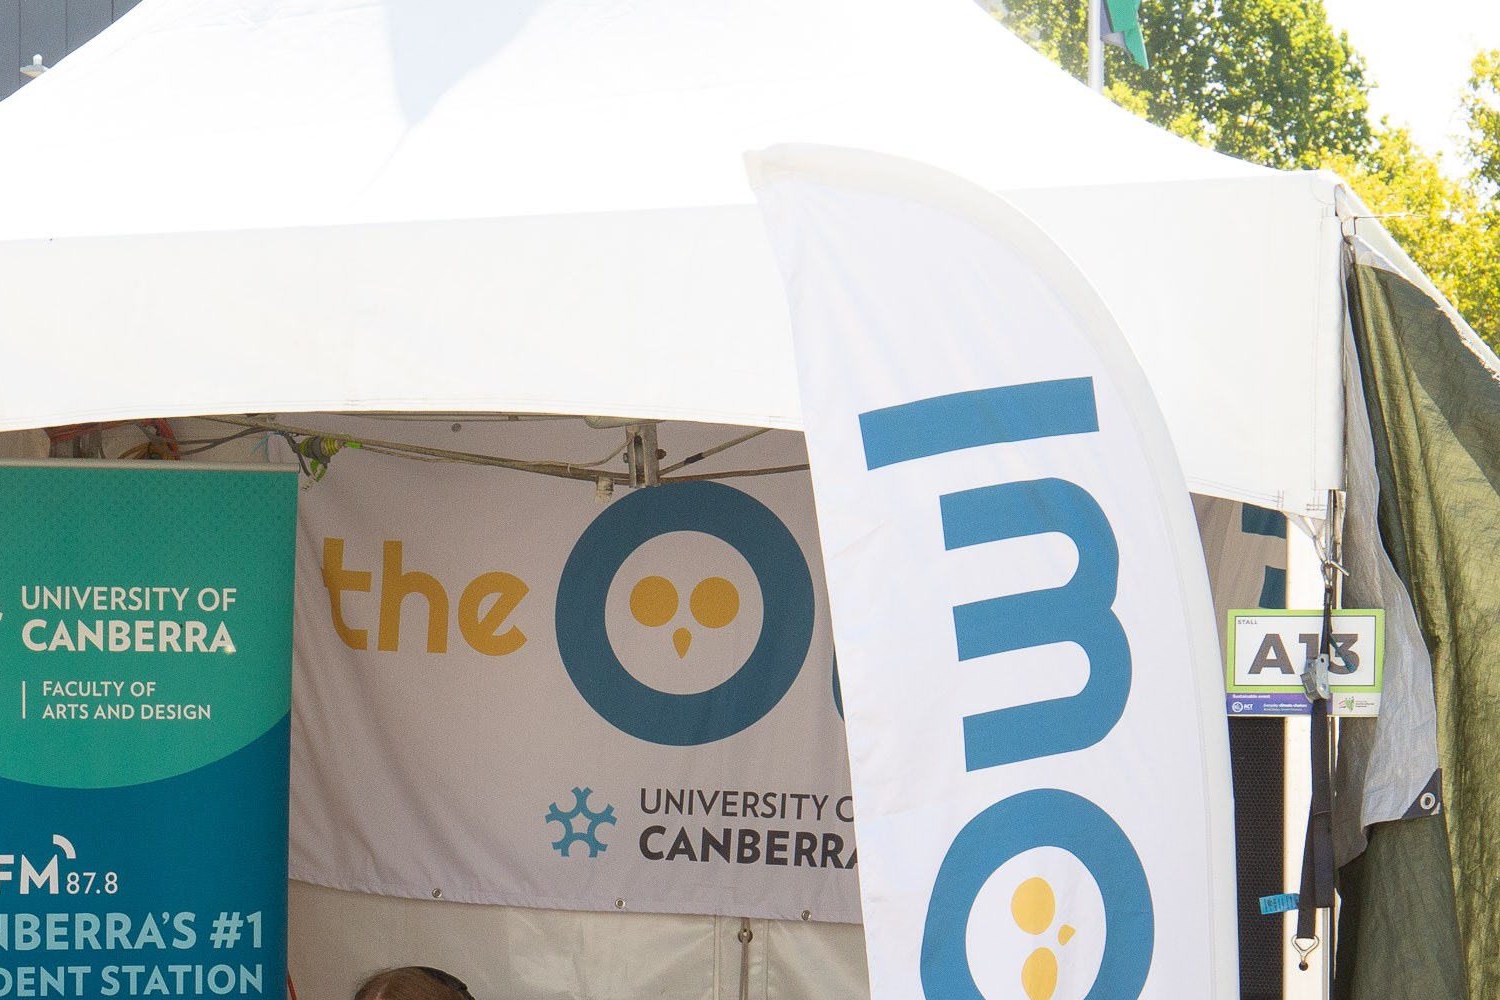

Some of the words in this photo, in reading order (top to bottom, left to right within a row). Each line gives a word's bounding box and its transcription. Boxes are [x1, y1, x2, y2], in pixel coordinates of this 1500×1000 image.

[21, 585, 190, 612] UNIVERSITY
[197, 587, 237, 613] OF
[321, 537, 531, 657] the
[21, 618, 237, 653] CANBERRA
[42, 680, 125, 698] FACULTY
[130, 681, 157, 698] OF
[42, 703, 90, 720] ARTS
[93, 704, 136, 720] AND
[140, 704, 211, 720] DESIGN
[639, 788, 828, 822] UNIVERSITY
[66, 871, 119, 895] 87.8
[209, 911, 263, 949] #1
[100, 963, 264, 996] STATION
